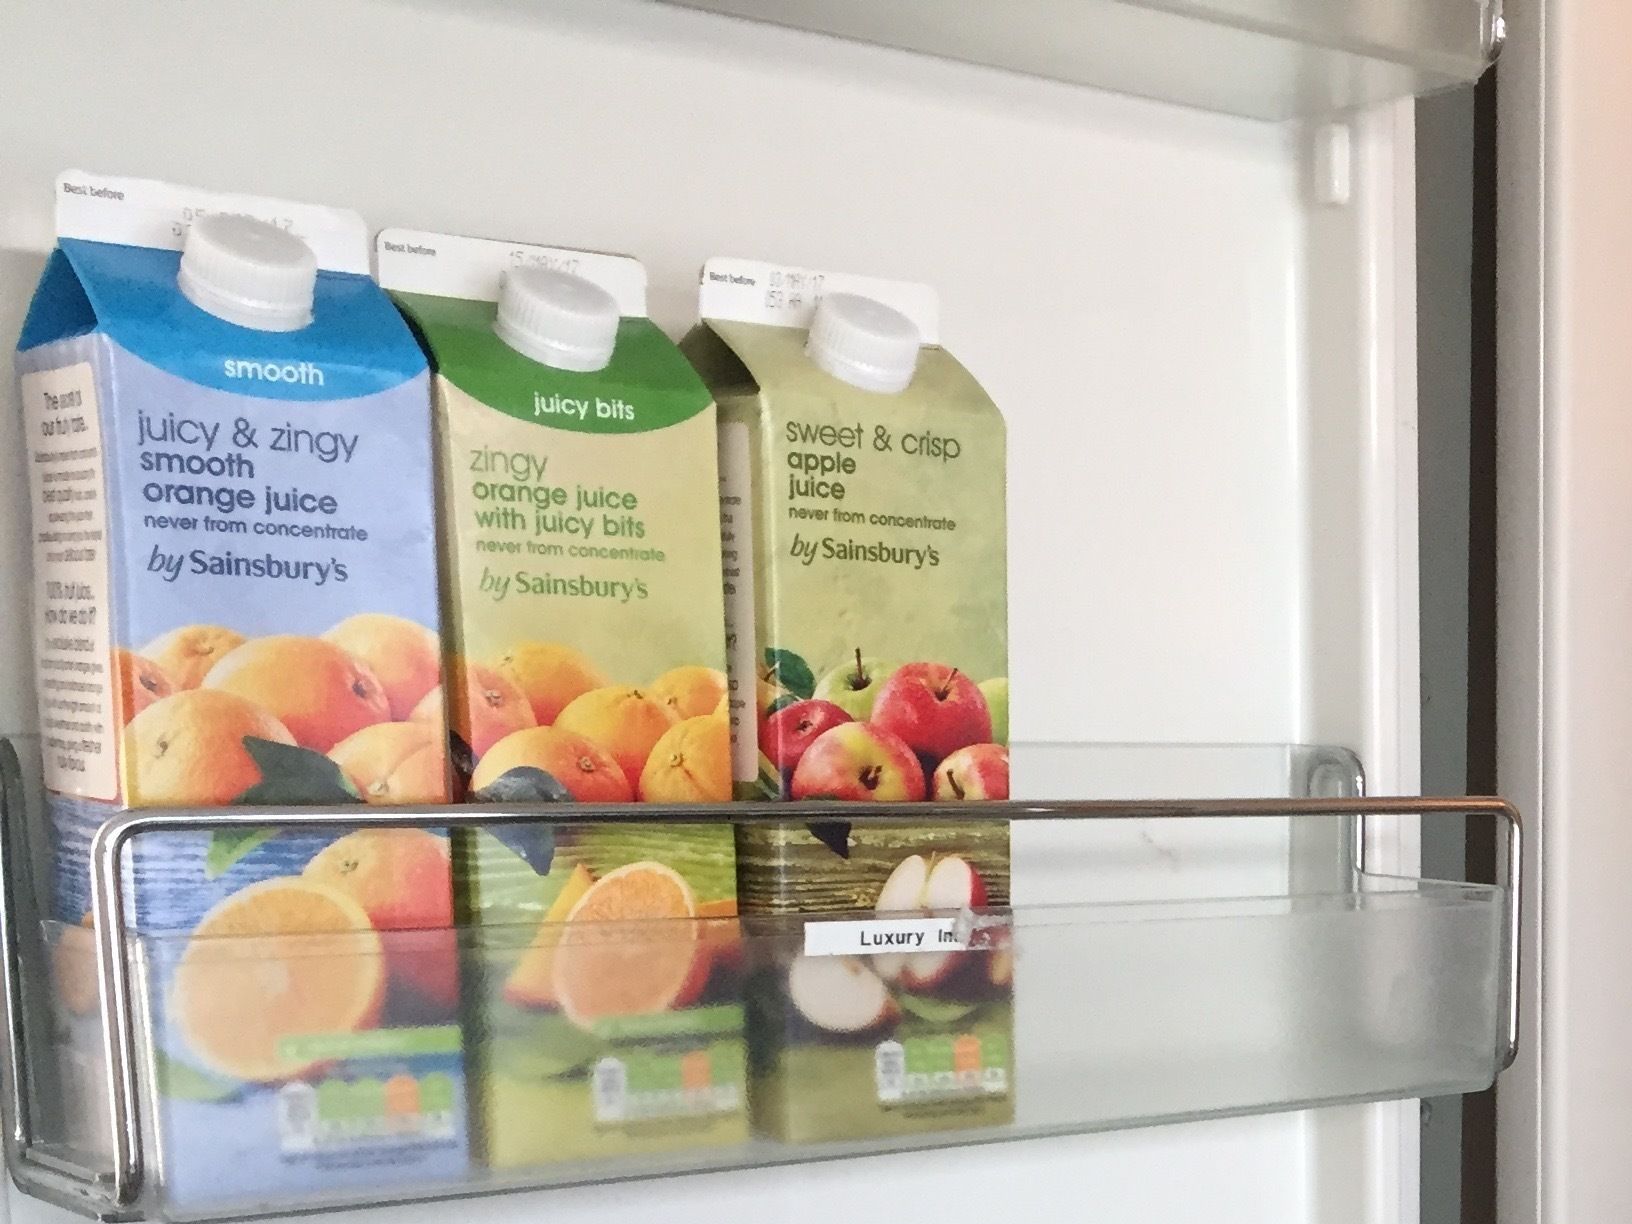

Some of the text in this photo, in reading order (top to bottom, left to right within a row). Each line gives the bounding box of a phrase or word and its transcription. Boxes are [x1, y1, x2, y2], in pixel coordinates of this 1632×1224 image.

[63, 182, 125, 201] Best before
[709, 271, 756, 286] Best before
[223, 357, 325, 387] smooth
[533, 391, 636, 422] juicy bits
[137, 410, 360, 464] juicy & zingy
[785, 418, 963, 463] sweet & crisp
[139, 449, 256, 480] smooth
[469, 445, 549, 483] zingy
[787, 448, 858, 476] apple
[142, 481, 339, 516] orange juice
[472, 481, 639, 515] orange juice
[787, 473, 847, 503] juice
[143, 514, 370, 543] never from concentrate
[474, 506, 647, 541] with juicy bits
[787, 503, 958, 532] never from concentrate
[146, 543, 350, 586] by Sainsbury's
[475, 537, 668, 565] never from concentrate
[789, 532, 942, 570] by Sainsbury's
[478, 567, 650, 604] by Sainsbury's
[860, 930, 925, 948] Luxury
